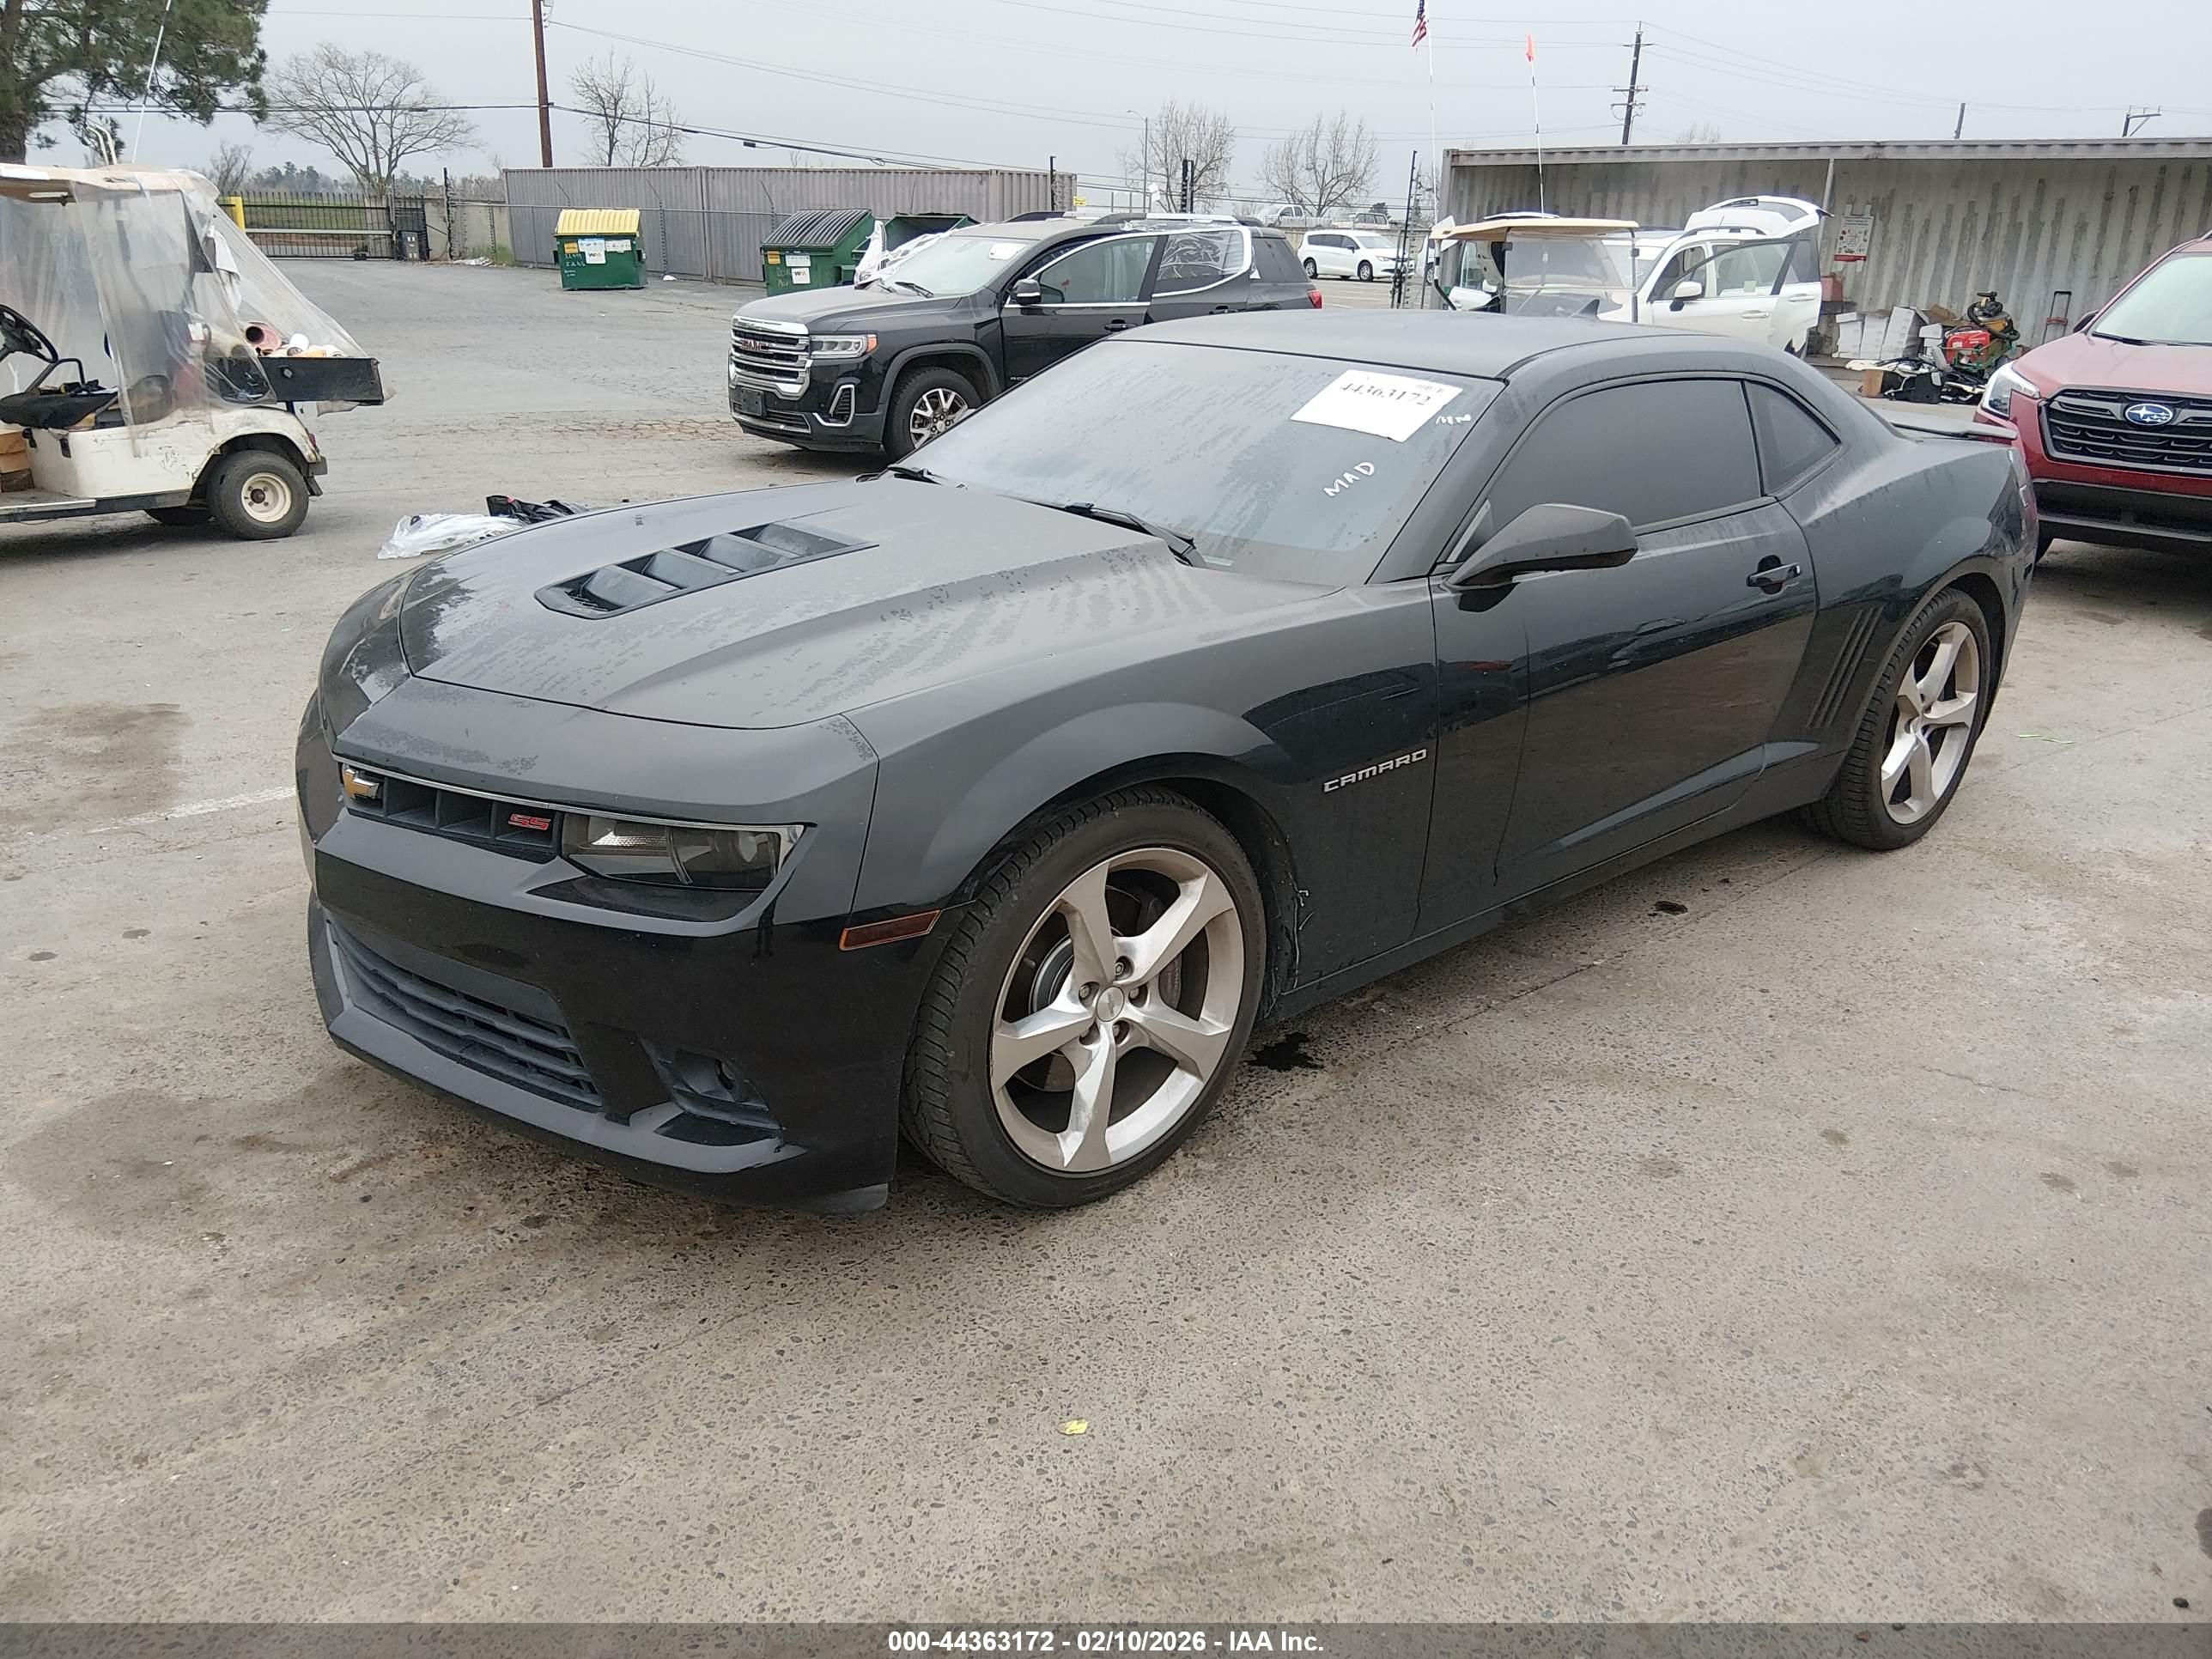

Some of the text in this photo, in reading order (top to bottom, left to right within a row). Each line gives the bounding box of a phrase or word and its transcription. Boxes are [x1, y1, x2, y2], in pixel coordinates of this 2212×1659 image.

[1323, 462, 1375, 497] MAD
[1323, 749, 1427, 793] CAMARO
[507, 813, 551, 830] SS
